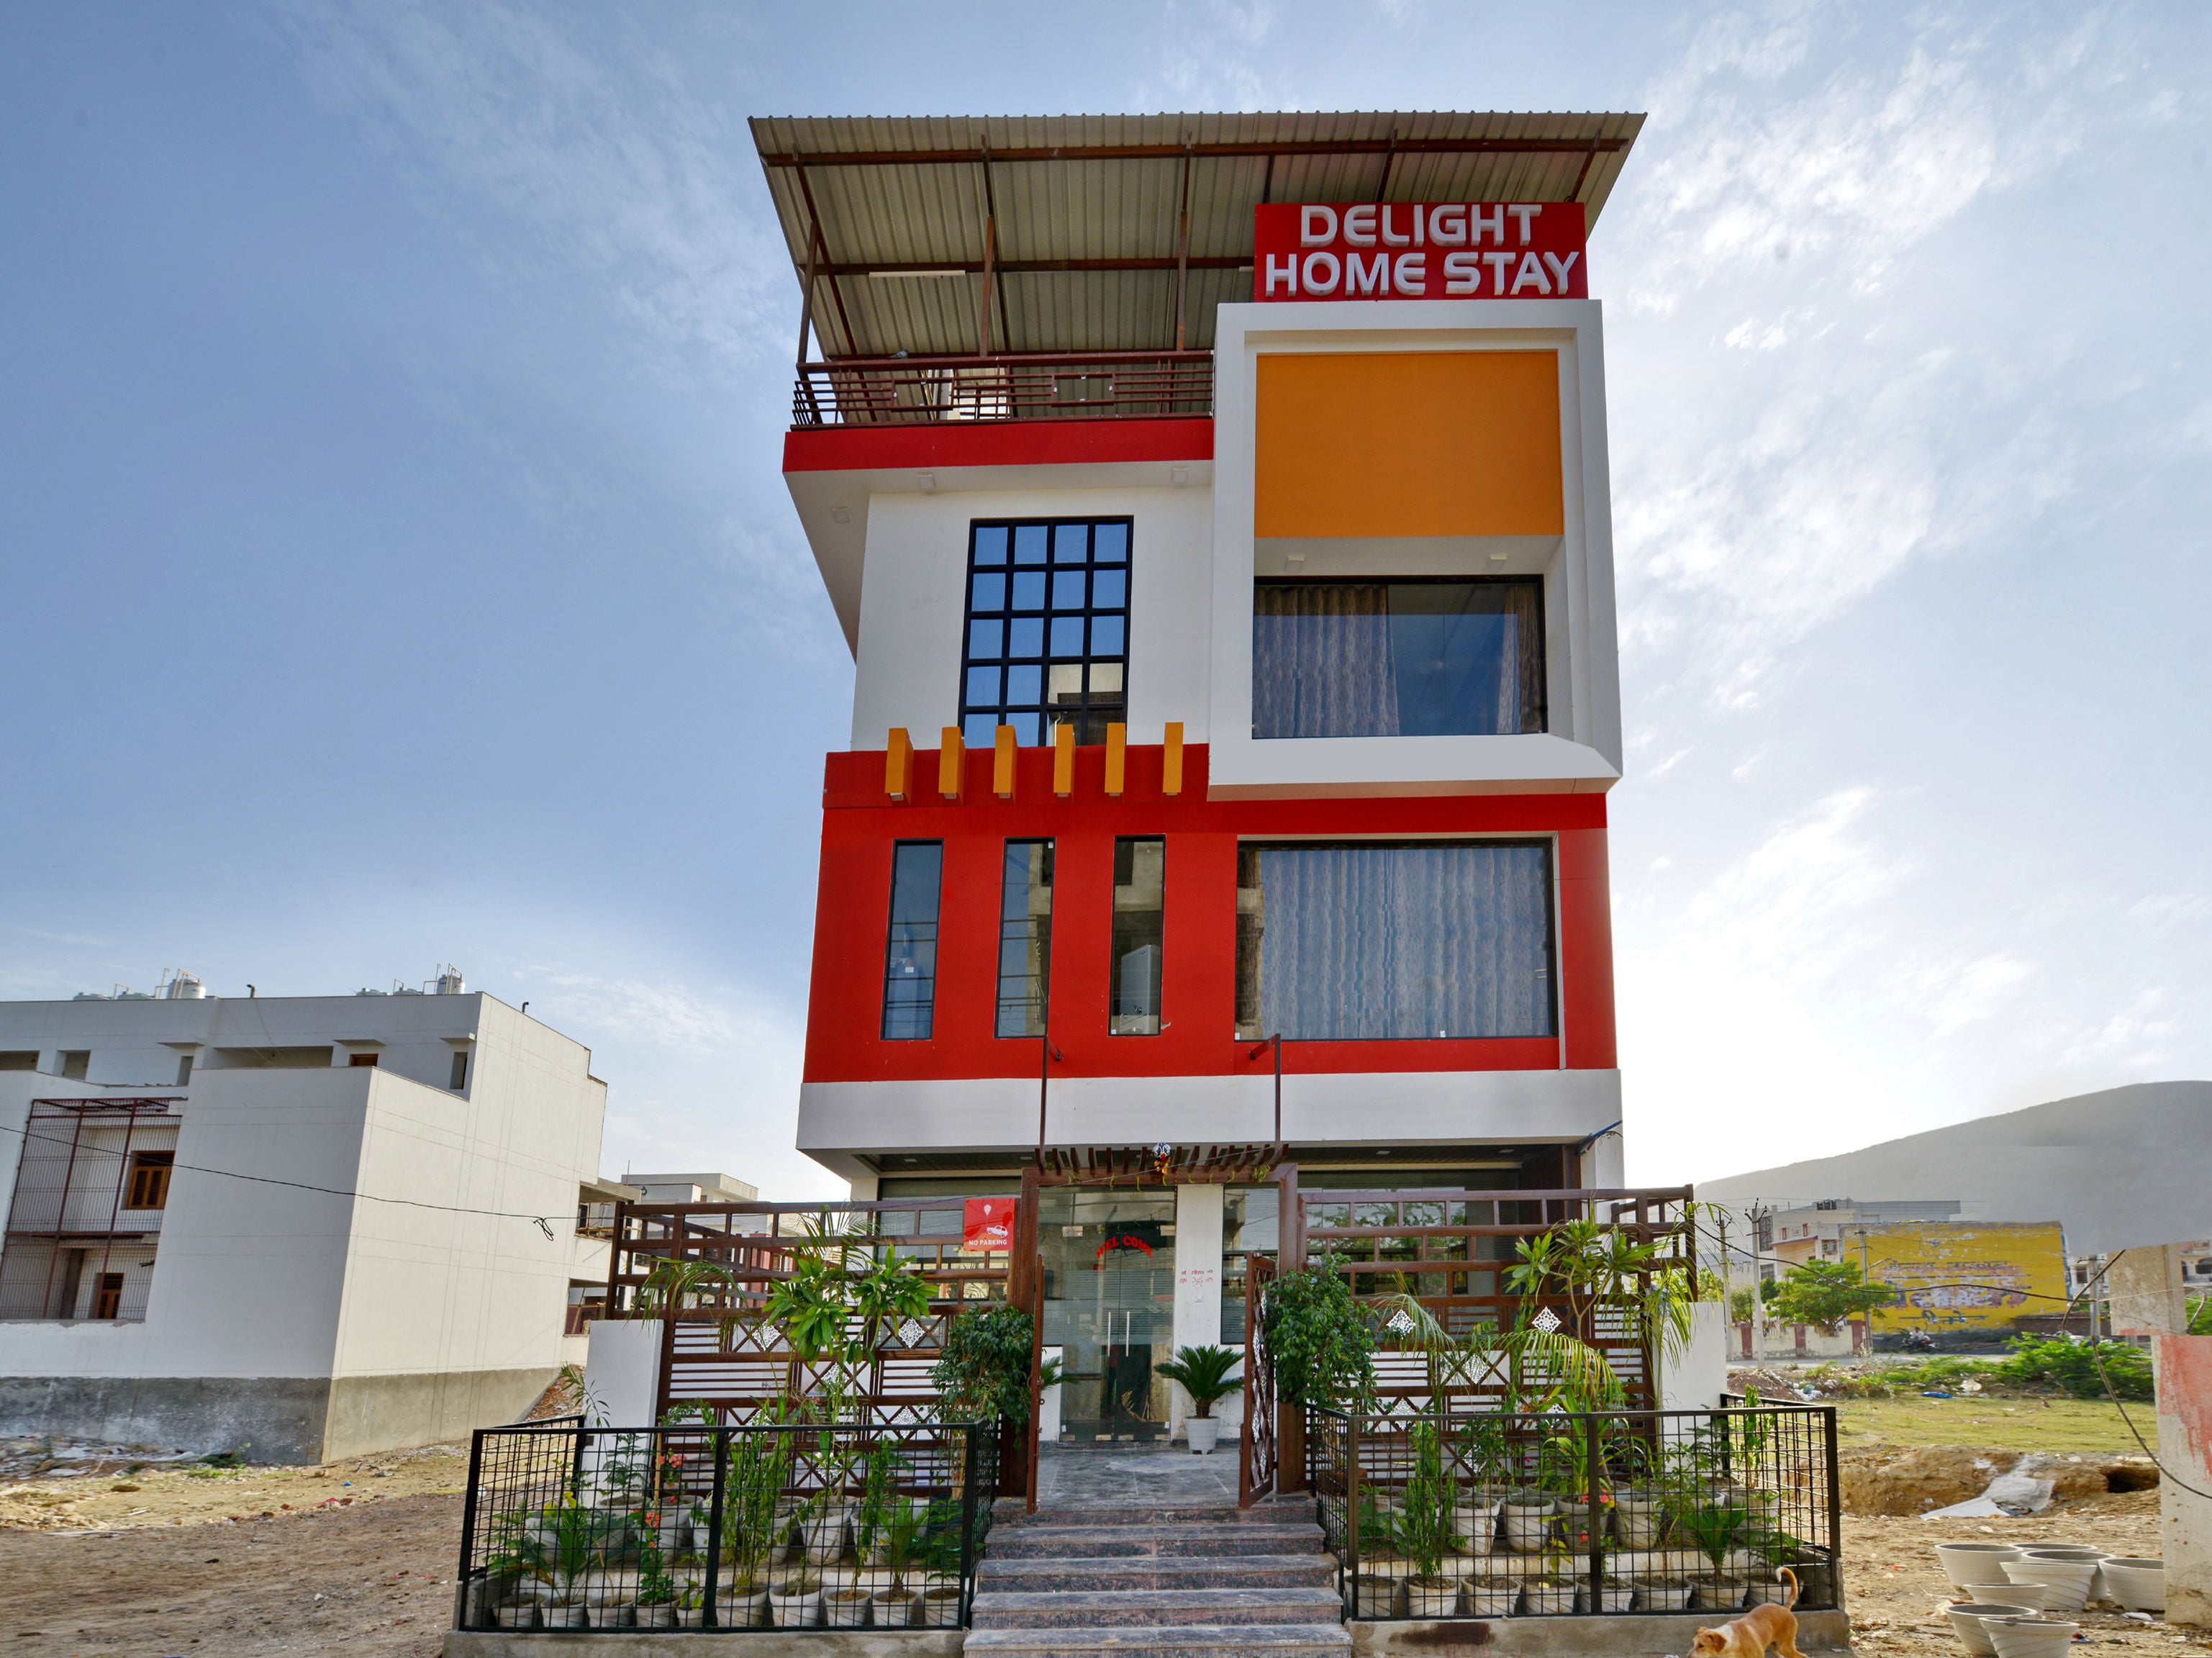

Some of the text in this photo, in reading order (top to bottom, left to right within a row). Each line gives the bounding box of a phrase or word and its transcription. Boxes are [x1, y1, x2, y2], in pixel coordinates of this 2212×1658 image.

[1300, 204, 1542, 248] DELIGHT
[1265, 251, 1579, 296] HOME STAY
